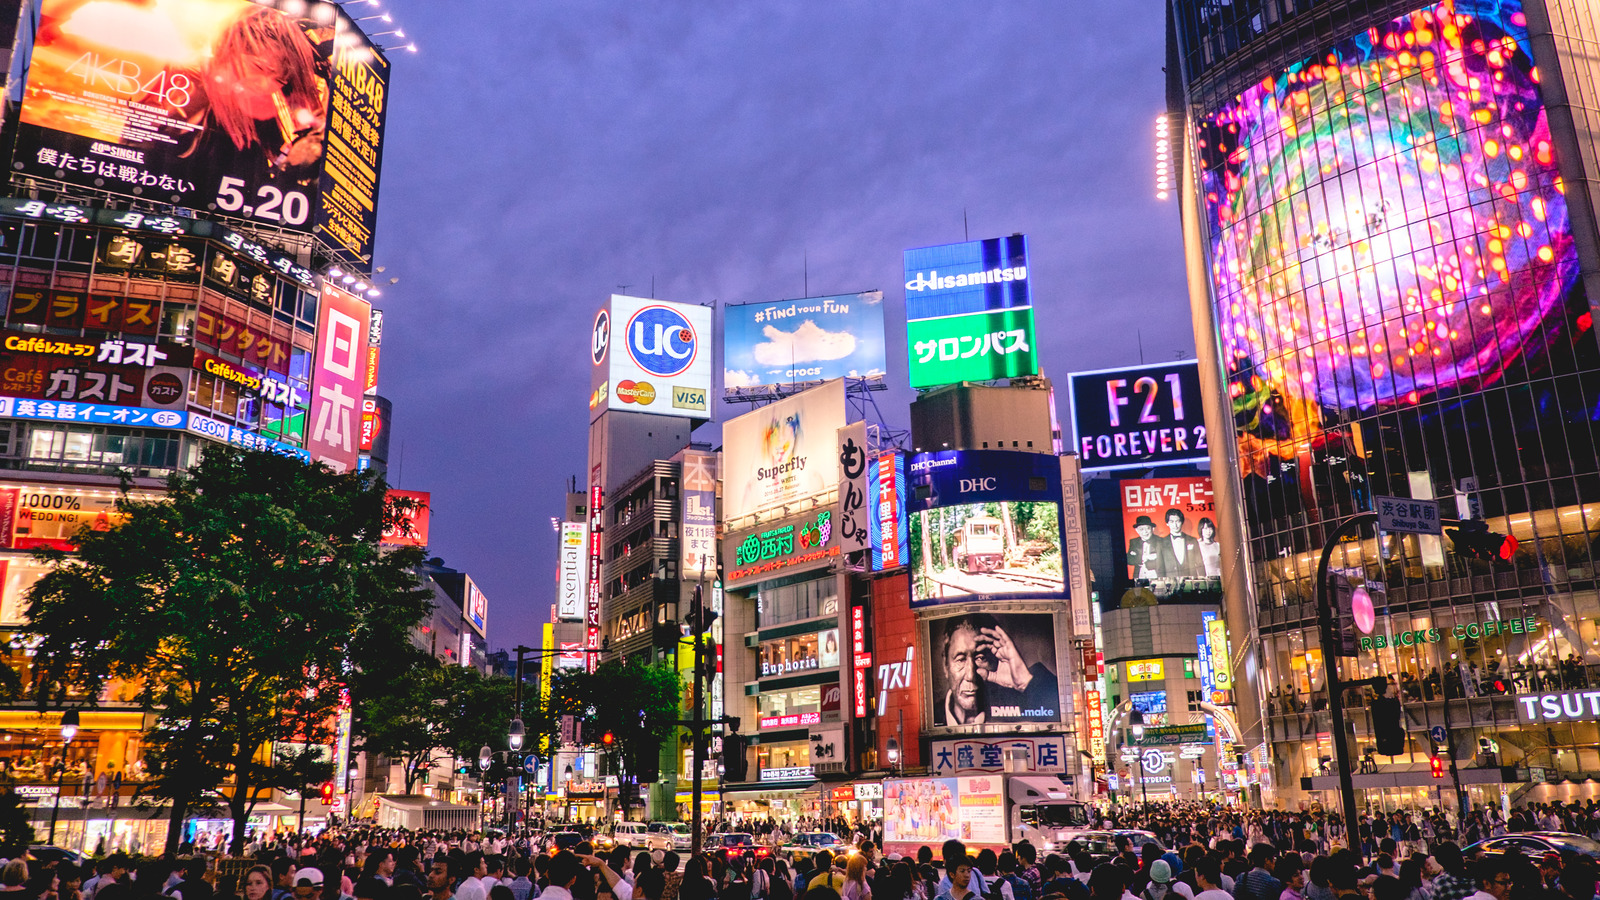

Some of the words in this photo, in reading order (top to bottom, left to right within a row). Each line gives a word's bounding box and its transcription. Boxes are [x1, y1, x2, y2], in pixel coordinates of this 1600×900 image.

[65, 52, 190, 108] AKB48
[336, 45, 384, 114] AKB48
[36, 148, 196, 192] 僕たちは戦わない
[216, 176, 310, 226] 5.20
[905, 266, 1027, 292] Hisamitsu
[14, 292, 156, 326] プライス
[797, 305, 822, 314] YOUR
[823, 300, 849, 314] FUN
[196, 310, 288, 364] コンタクト
[914, 329, 1030, 364] サロンパス
[97, 340, 168, 366] ガスト
[4, 367, 44, 385] Café
[786, 367, 822, 378] crocs
[2, 382, 42, 394] レストラン
[46, 368, 136, 402] ガスト
[151, 386, 179, 396] ガスト
[260, 376, 302, 408] ガスト
[313, 308, 360, 474] 日本
[617, 386, 656, 398] MasterCard
[677, 392, 705, 406] VISA
[1106, 373, 1184, 426] F21
[17, 400, 148, 424] 英会話イーオン
[158, 412, 176, 424] 6F
[192, 415, 226, 438] AEON
[362, 421, 372, 444] ガスト
[1082, 427, 1188, 460] FOREVER
[757, 456, 808, 481] Superfly
[910, 462, 926, 472] DHC
[927, 457, 957, 468] Channel
[840, 438, 868, 546] もんじゃ
[960, 477, 996, 493] DHC
[1124, 482, 1214, 507] 日本ダービー
[22, 494, 80, 510] 1000%
[879, 460, 894, 562] 三千里薬品
[1382, 501, 1434, 520] 渋谷駅前
[19, 510, 79, 522] WEDDING!
[1392, 519, 1416, 530] Shibuya
[685, 526, 716, 538] 夜11時
[690, 540, 708, 550] まで
[760, 533, 794, 560] 西村
[562, 546, 578, 616] Essential
[1452, 617, 1538, 640] COFFEE
[762, 656, 817, 676] Euphoria
[991, 706, 1054, 718] DMM.make
[1520, 692, 1600, 720] TSUT
